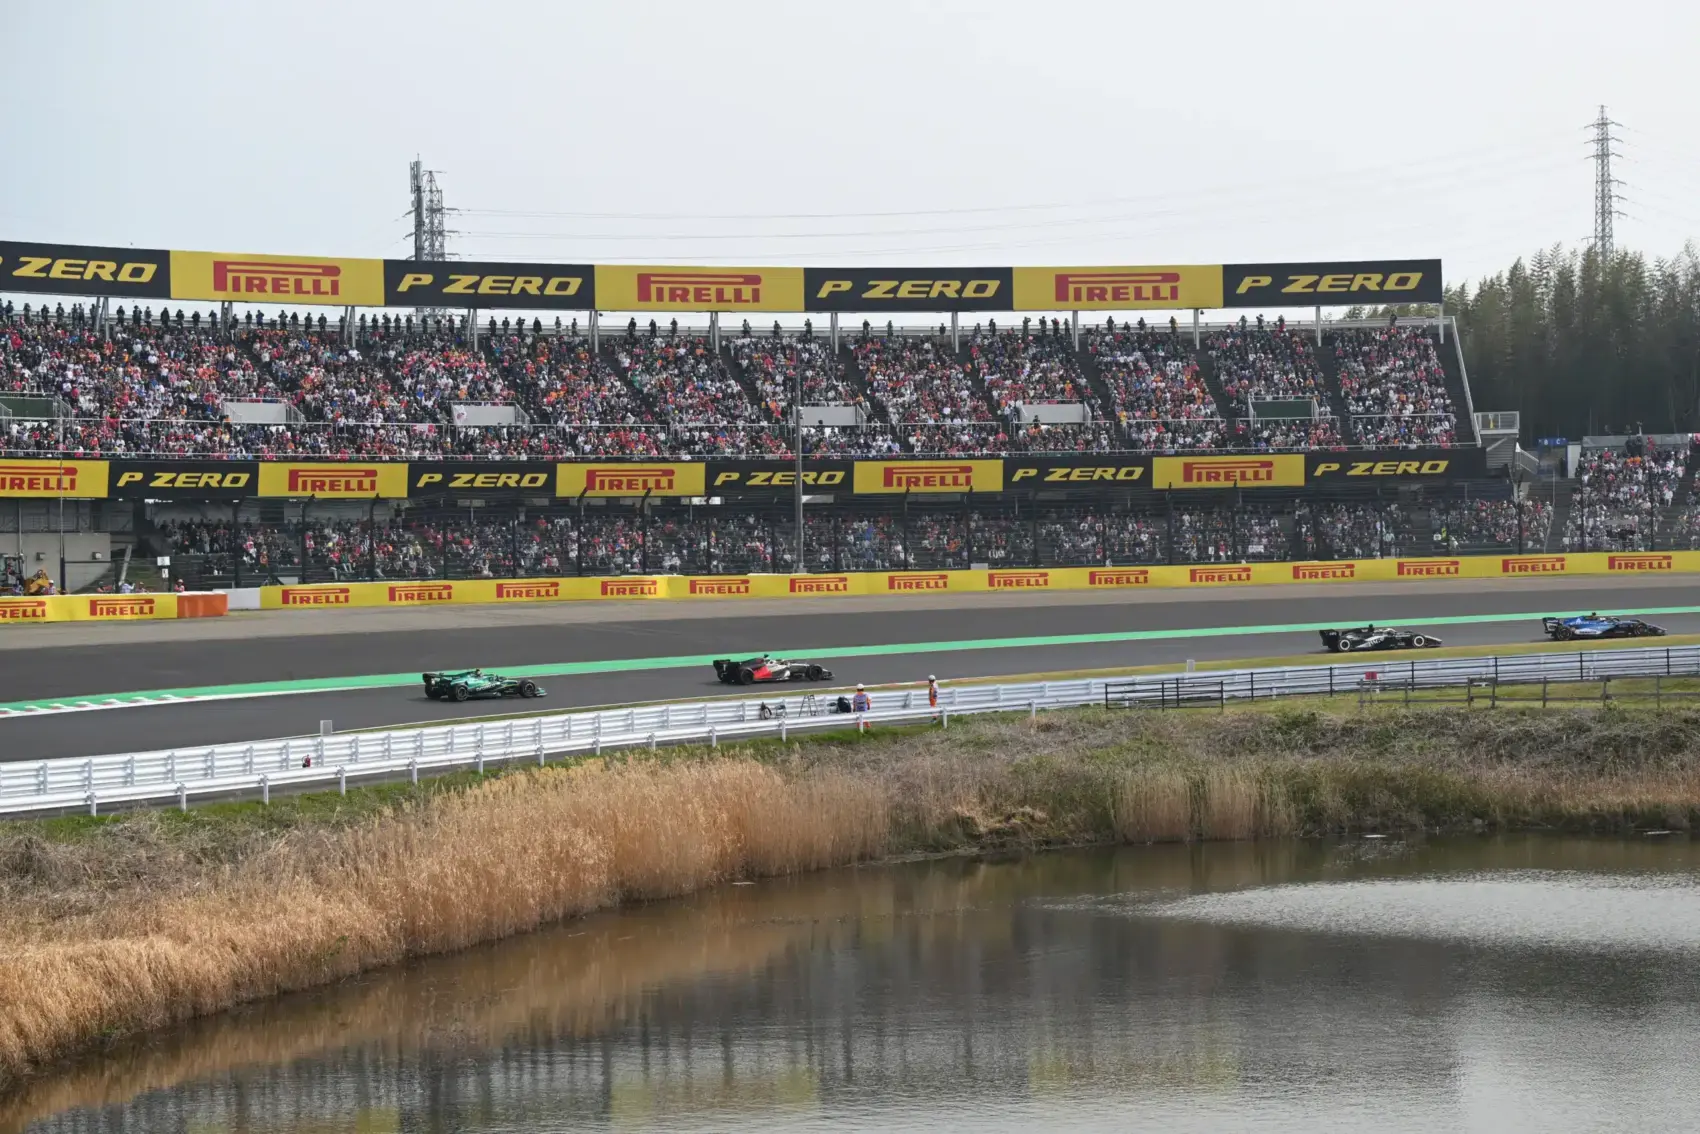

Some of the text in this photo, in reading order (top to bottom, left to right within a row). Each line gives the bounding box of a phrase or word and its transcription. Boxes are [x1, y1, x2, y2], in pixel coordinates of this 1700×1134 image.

[12, 256, 158, 283] ZERO
[213, 260, 341, 296] PIRELLI
[397, 273, 583, 296] P ZERO
[637, 273, 762, 304] PIRELLI
[816, 279, 1001, 299] P ZERO
[1054, 272, 1180, 302] PIRELLI
[1236, 272, 1423, 294] P ZERO
[883, 466, 973, 487] PIRELLI
[1012, 466, 1144, 482] P ZERO
[1182, 460, 1274, 483] PIRELLI
[1313, 460, 1449, 477] P ZERO
[117, 472, 251, 488] P ZERO
[288, 469, 377, 492] PIRELLI
[416, 473, 548, 488] P ZERO
[585, 468, 676, 491] PIRELLI
[713, 471, 846, 486] P ZERO
[1292, 563, 1355, 579] PIRELLI
[1397, 560, 1460, 576] PIRELLI
[1502, 556, 1566, 573] PIRELLI
[1608, 555, 1672, 570] PIRELLI
[889, 574, 948, 589] PIRELLI
[988, 572, 1048, 588] PIRELLI
[1089, 570, 1149, 585] PIRELLI
[1189, 567, 1251, 583] PIRELLI
[388, 584, 453, 602] PIRELLI
[496, 582, 560, 599] PIRELLI
[600, 580, 657, 596] PIRELLI
[690, 580, 750, 594] PIRELLI
[790, 578, 848, 592] PIRELLI
[281, 588, 350, 605] PIRELLI
[0, 600, 46, 618] RELLI
[90, 598, 155, 616] PIRELLI
